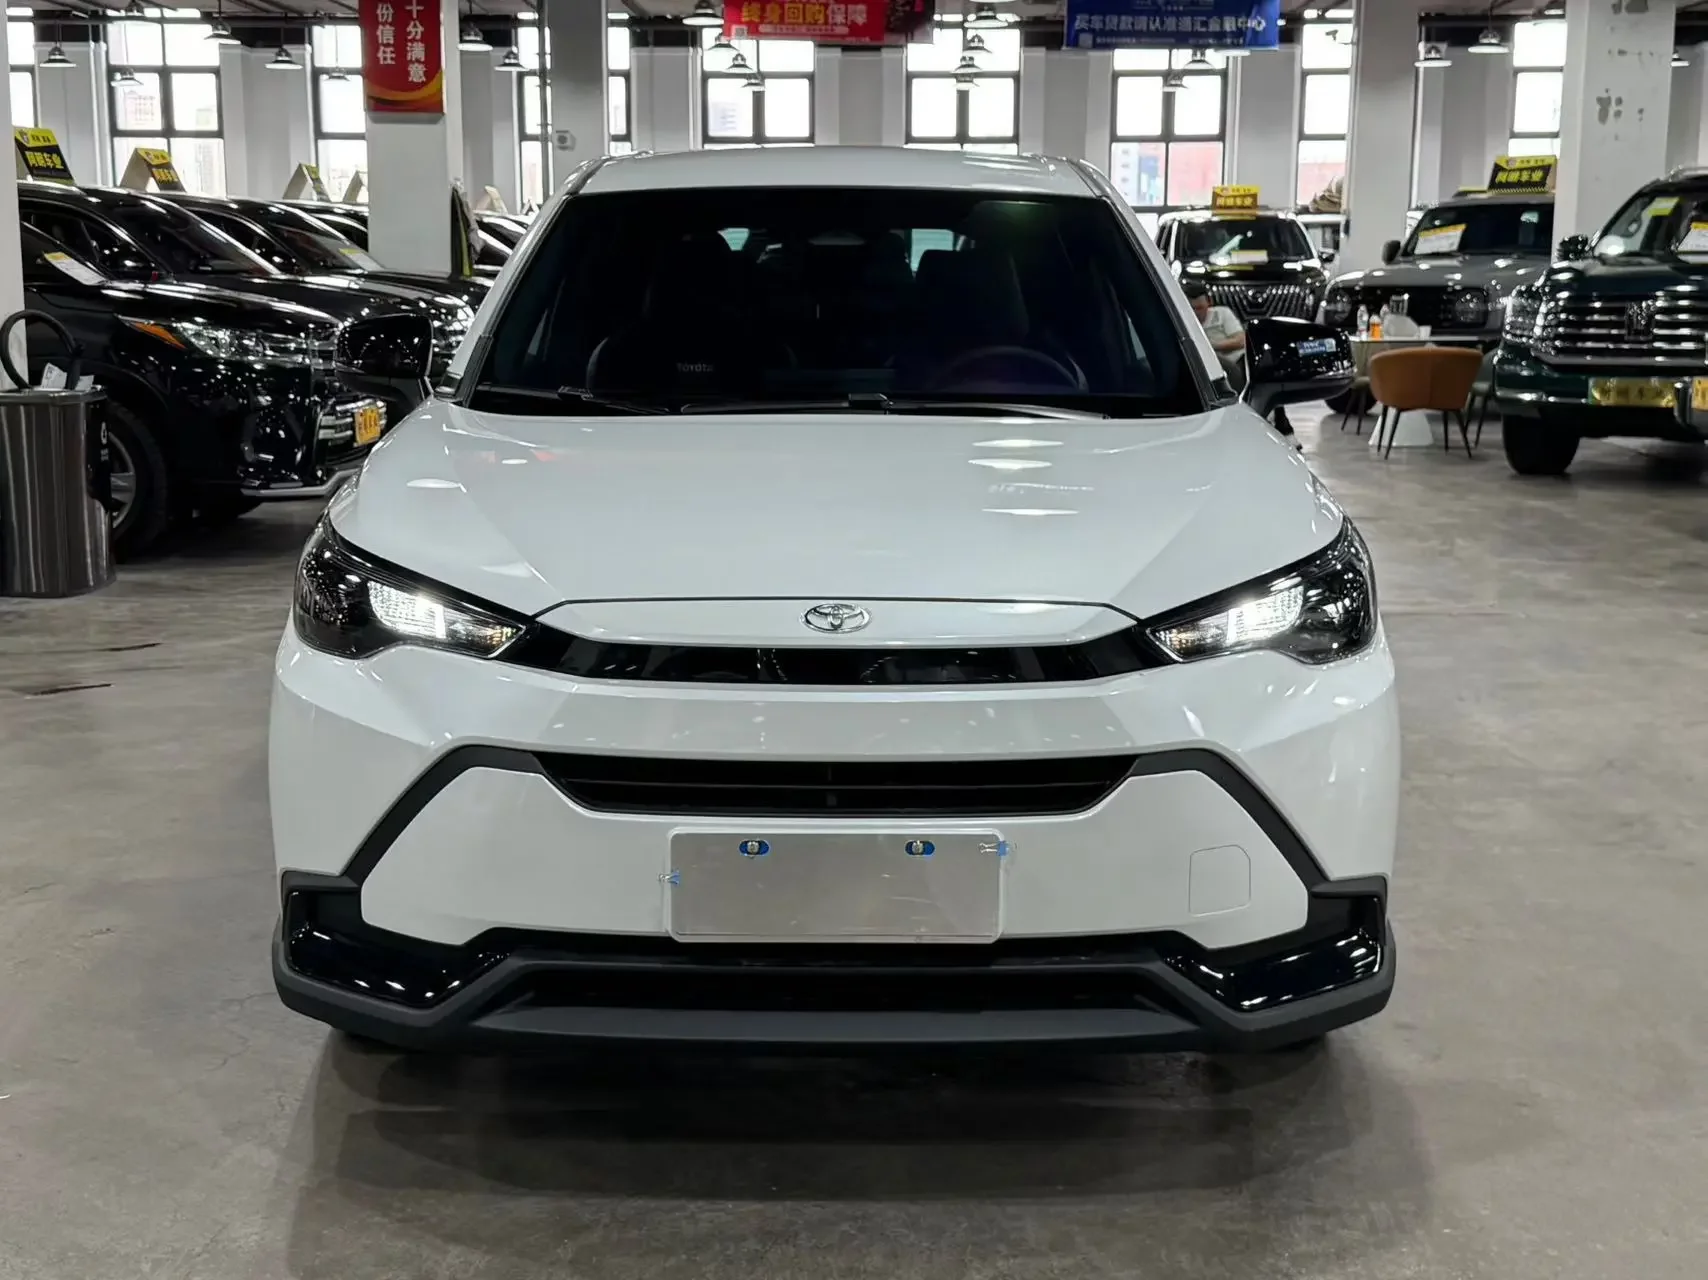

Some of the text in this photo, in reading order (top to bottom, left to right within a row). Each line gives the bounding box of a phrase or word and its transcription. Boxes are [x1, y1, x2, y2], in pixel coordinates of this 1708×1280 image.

[376, 3, 396, 65] 份信任
[405, 0, 427, 83] 十分满意
[676, 361, 714, 372] TOYOTA
